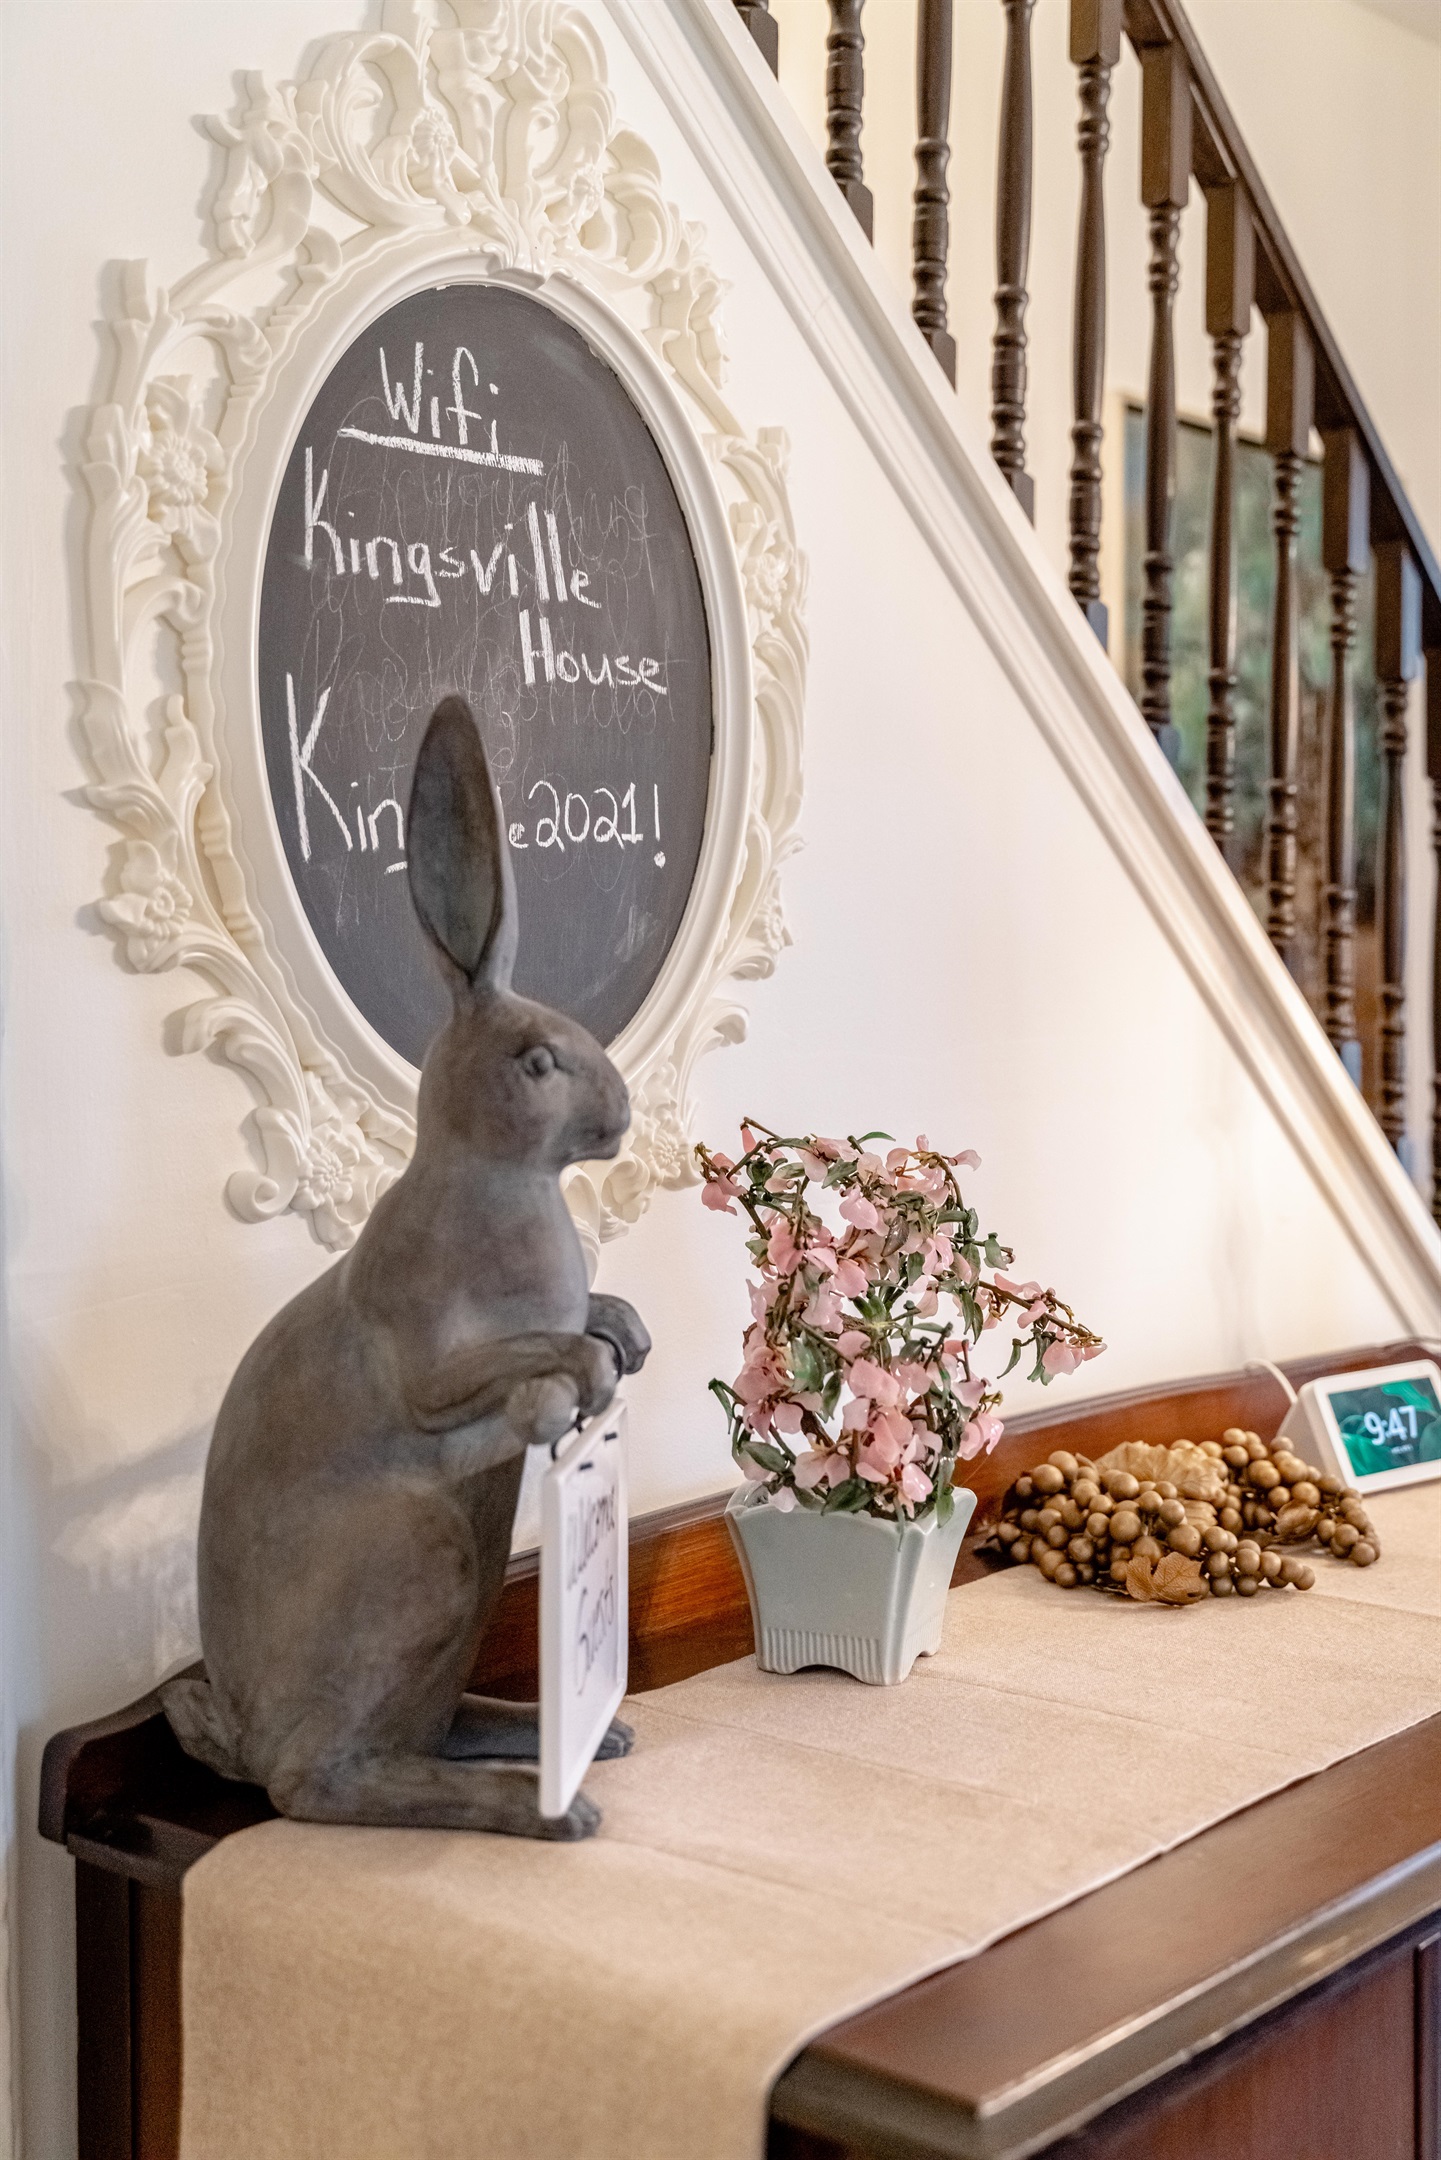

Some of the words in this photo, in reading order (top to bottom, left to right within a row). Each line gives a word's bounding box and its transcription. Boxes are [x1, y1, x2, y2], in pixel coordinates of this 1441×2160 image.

[379, 341, 499, 453] Wifi
[304, 446, 602, 608] Kingsville
[519, 609, 668, 695] House
[1363, 1405, 1418, 1446] 9:47
